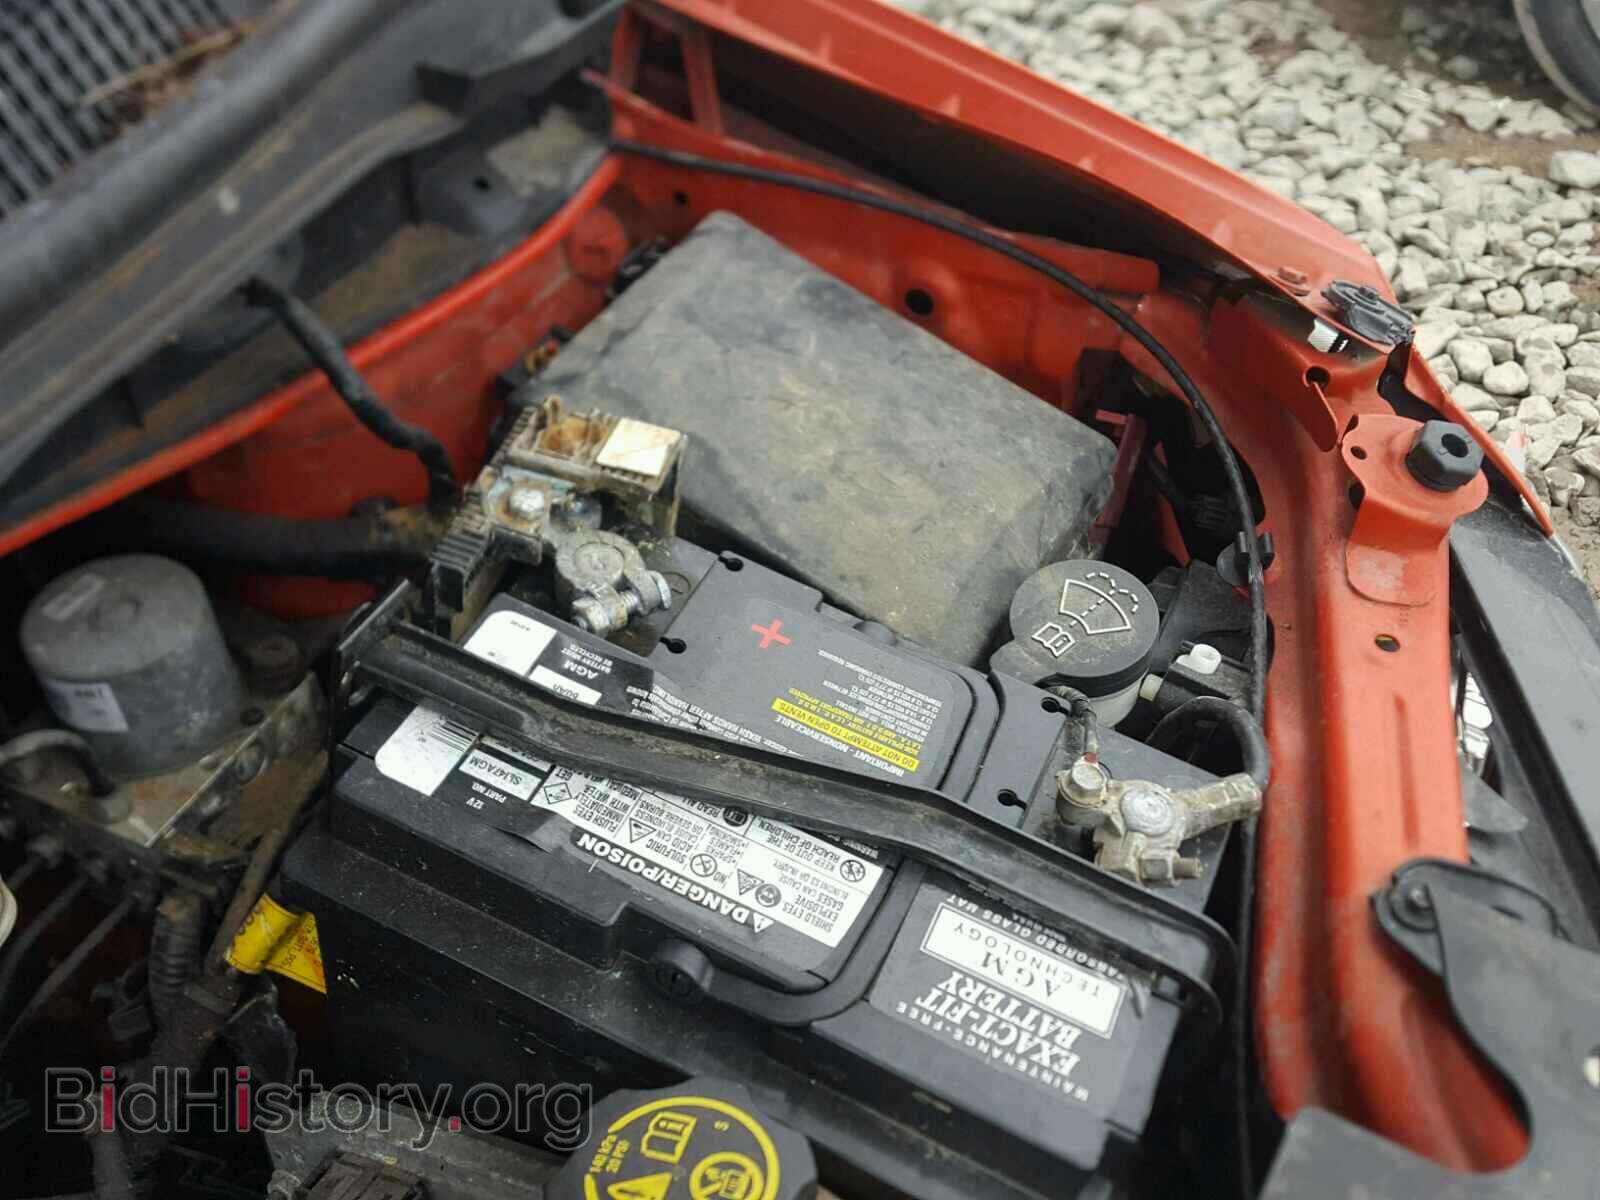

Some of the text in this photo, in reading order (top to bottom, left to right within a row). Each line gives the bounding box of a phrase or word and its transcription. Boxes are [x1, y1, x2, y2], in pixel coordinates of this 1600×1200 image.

[560, 646, 611, 673] BATTERY MUST
[563, 658, 598, 681] AGM
[688, 703, 713, 721] AFTER
[806, 715, 830, 730] OPEN
[773, 712, 849, 754] NONSERVICEABLE
[829, 725, 842, 735] TO
[842, 730, 882, 753] ATTEMPT
[852, 747, 904, 778] IMPORTANT
[882, 748, 900, 761] NOT
[901, 757, 914, 768] DO
[555, 766, 573, 782] GET
[485, 787, 507, 803] PART
[573, 790, 624, 823] IMMEDIATELY
[608, 796, 630, 813] WITH
[572, 803, 618, 833] FLUSH EYES
[663, 811, 691, 830] SEVERE
[694, 799, 720, 818] READ
[634, 807, 697, 844] CAUSE BLINDNESS
[644, 836, 687, 865] SULFURIC
[655, 829, 693, 853] ACID CAN
[765, 833, 835, 874] KEEP OUT OF THE
[798, 837, 812, 850] OF
[810, 842, 840, 864] REACH
[576, 829, 750, 924] DANGER/POISON
[712, 869, 727, 884] NO
[808, 875, 848, 901] BLINDNESS
[777, 873, 843, 912] GASES CAN CAUSE
[945, 891, 979, 914] MAT
[780, 900, 834, 933] SHIELD EYES
[793, 892, 838, 923] EXPLOSIVE
[981, 908, 1032, 939] GLASS
[952, 919, 1102, 998] TECHNOLOGY
[978, 950, 1061, 1000] AGM
[935, 965, 1083, 1051] BATTERY
[913, 982, 1081, 1078] EXACT-FIT
[894, 999, 1090, 1102] MAINTENANCE-FREE
